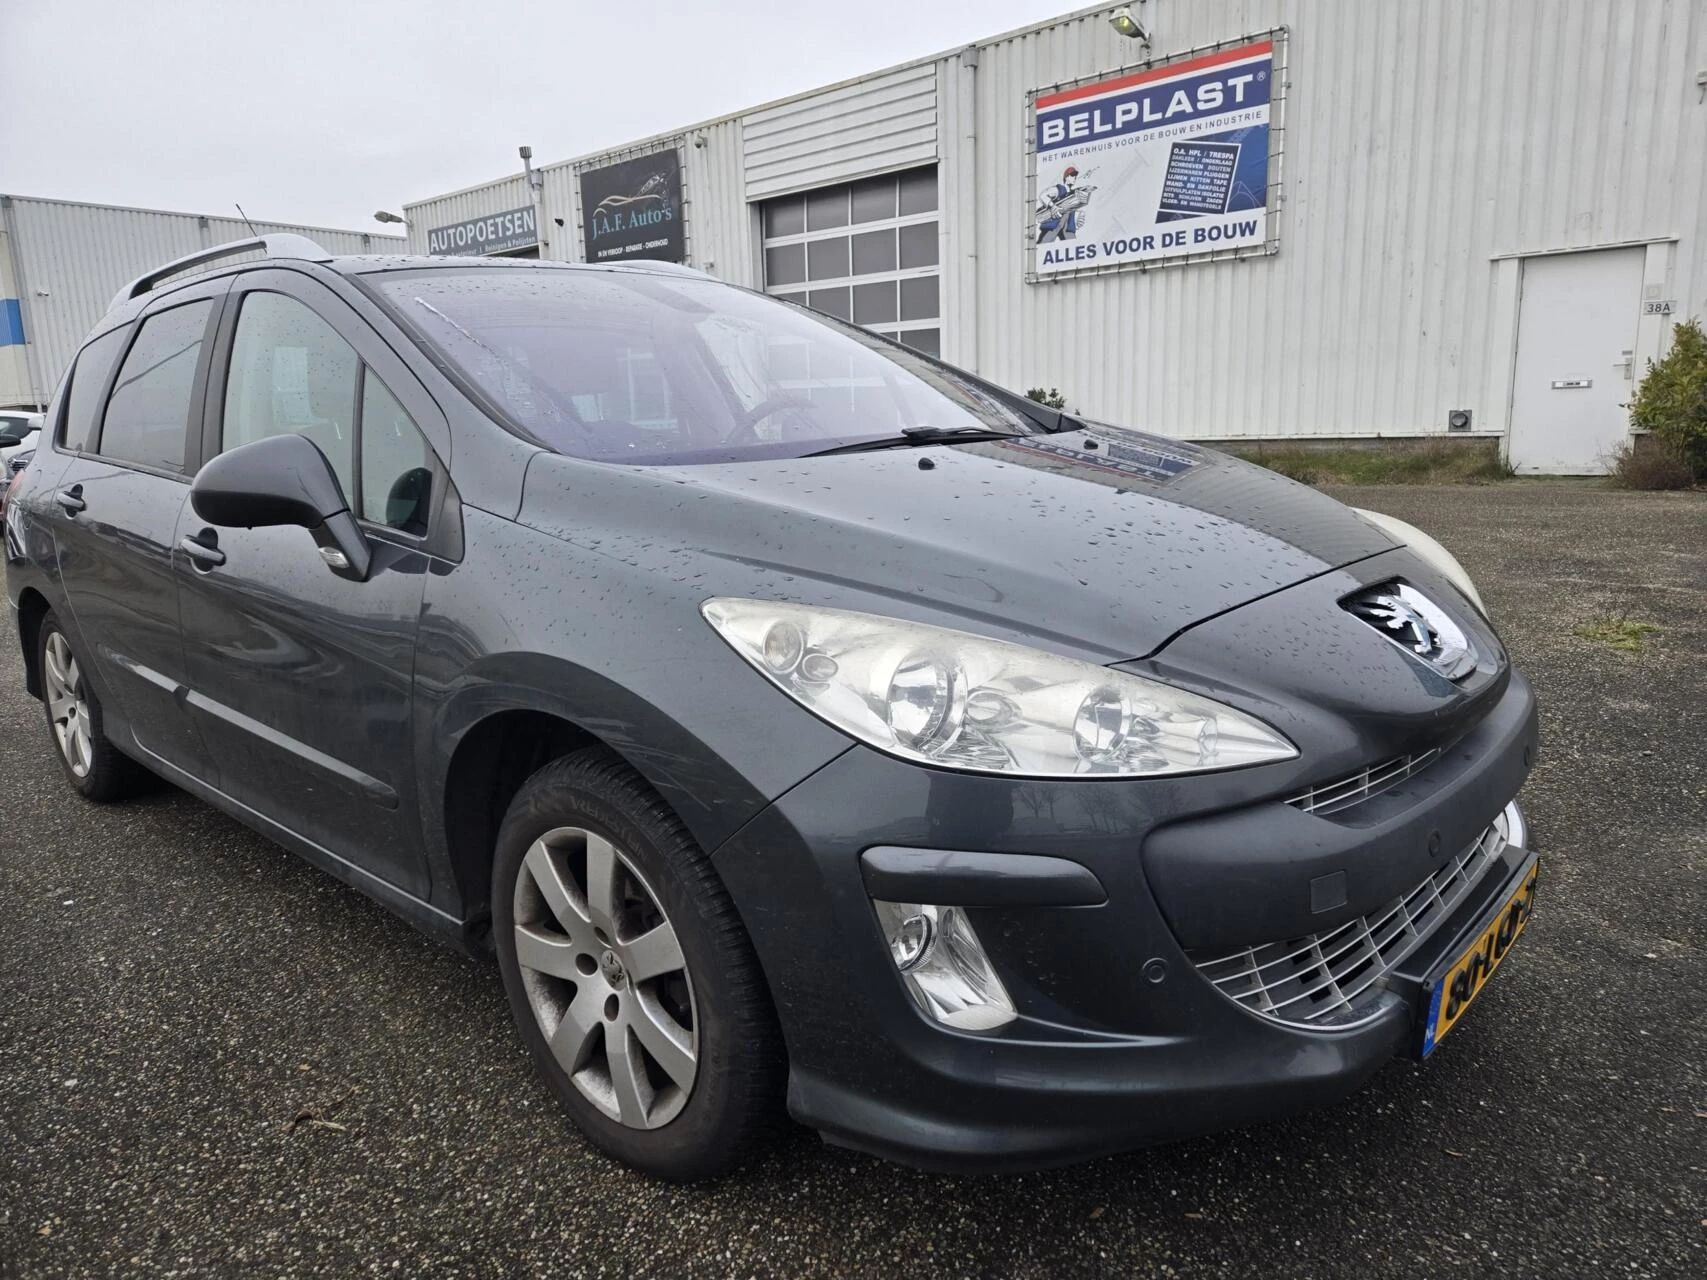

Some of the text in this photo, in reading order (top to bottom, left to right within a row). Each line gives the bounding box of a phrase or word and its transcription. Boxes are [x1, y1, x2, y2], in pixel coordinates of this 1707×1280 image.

[1043, 74, 1254, 145] BELPLAST
[1042, 110, 1262, 163] HET WARENHUIS VOOR DE BOUW EN INDUSTRIE
[430, 209, 535, 253] AUTOPOETSEN
[592, 207, 673, 240] J.A.F. Auto's
[1042, 220, 1258, 265] ALLES VOOR DE BOUW
[1647, 302, 1671, 313] 38A
